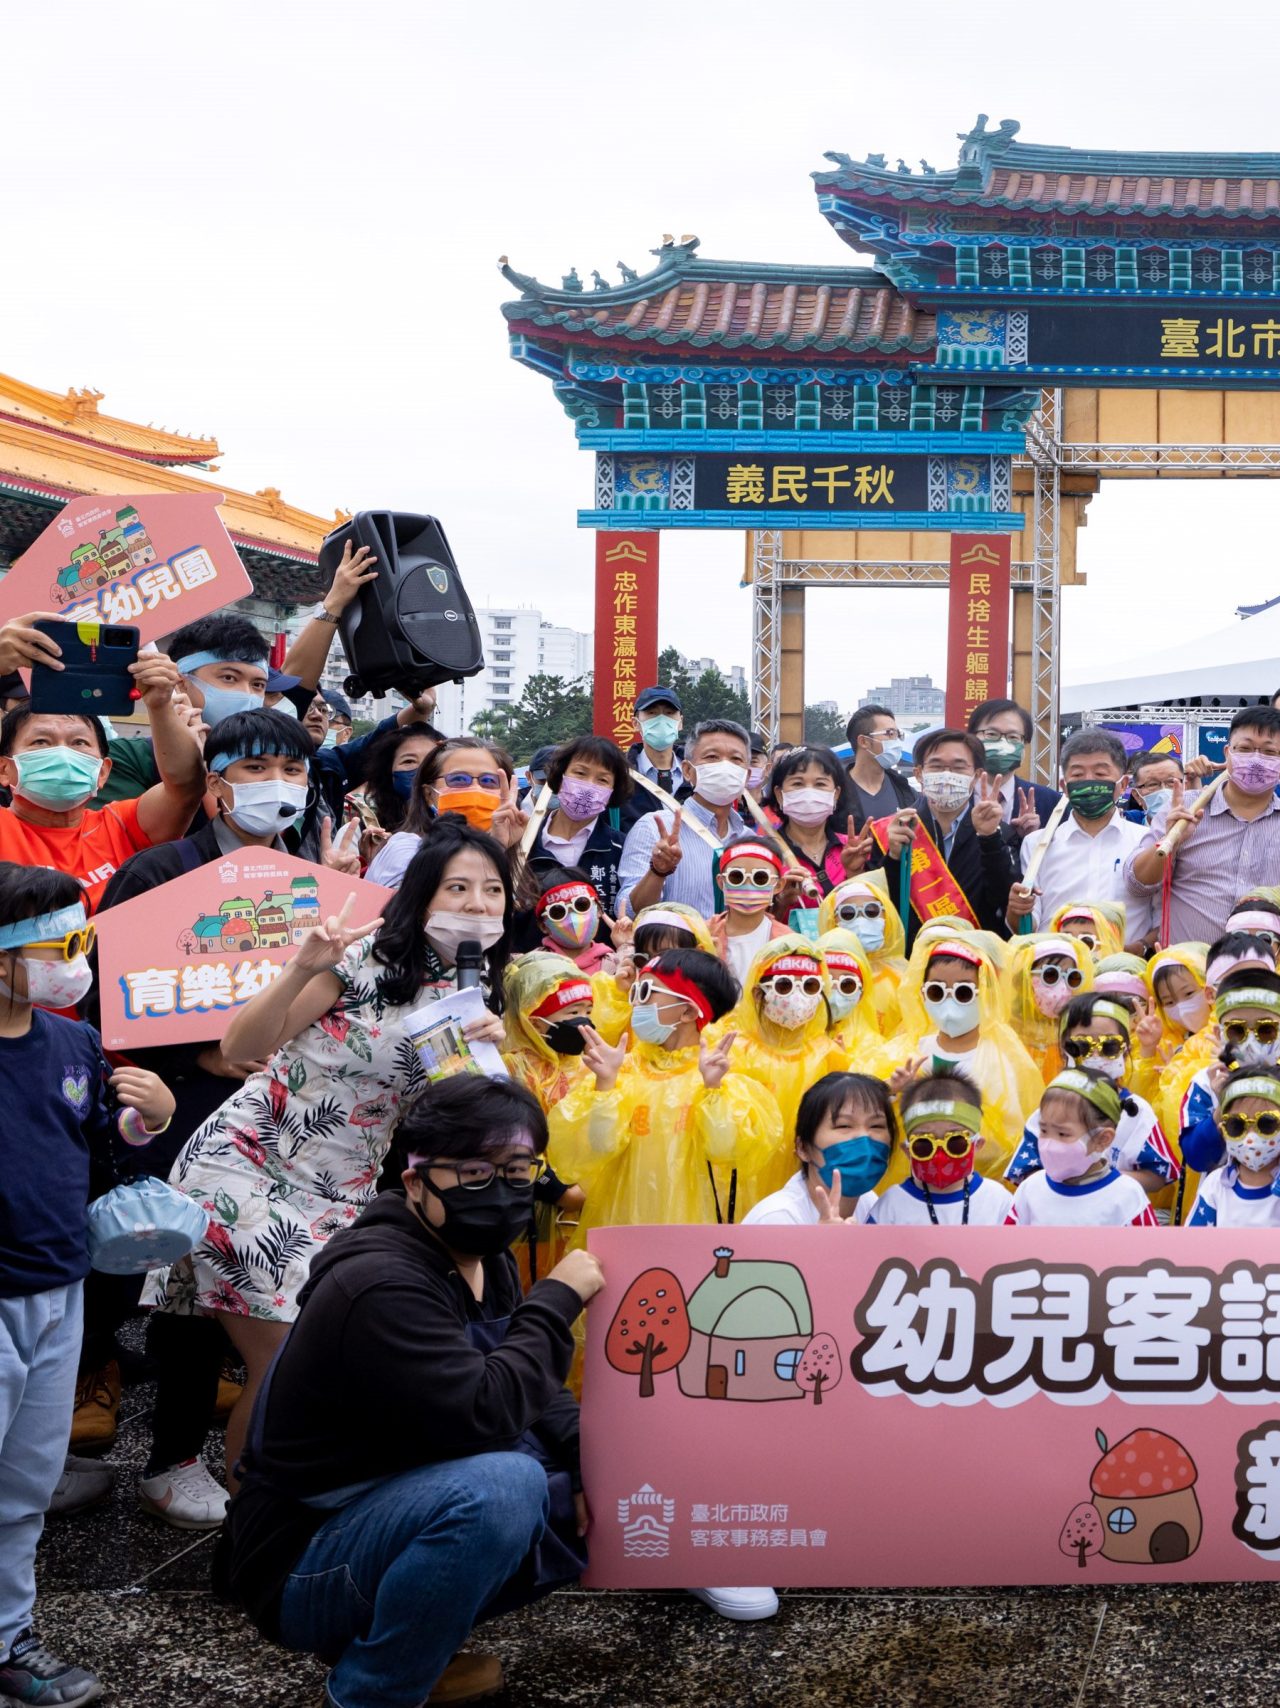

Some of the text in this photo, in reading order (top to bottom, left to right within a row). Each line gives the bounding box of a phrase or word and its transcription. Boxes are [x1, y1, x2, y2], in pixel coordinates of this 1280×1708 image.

[726, 463, 895, 505] 義民千秋
[964, 573, 991, 728] 民捨生軀歸
[612, 570, 638, 753] 忠作東瀛保障從今
[772, 956, 819, 972] HAKKA
[825, 953, 860, 970] AKKA
[690, 1503, 789, 1523] 臺北市政府
[690, 1529, 828, 1548] 客家事務委員會
